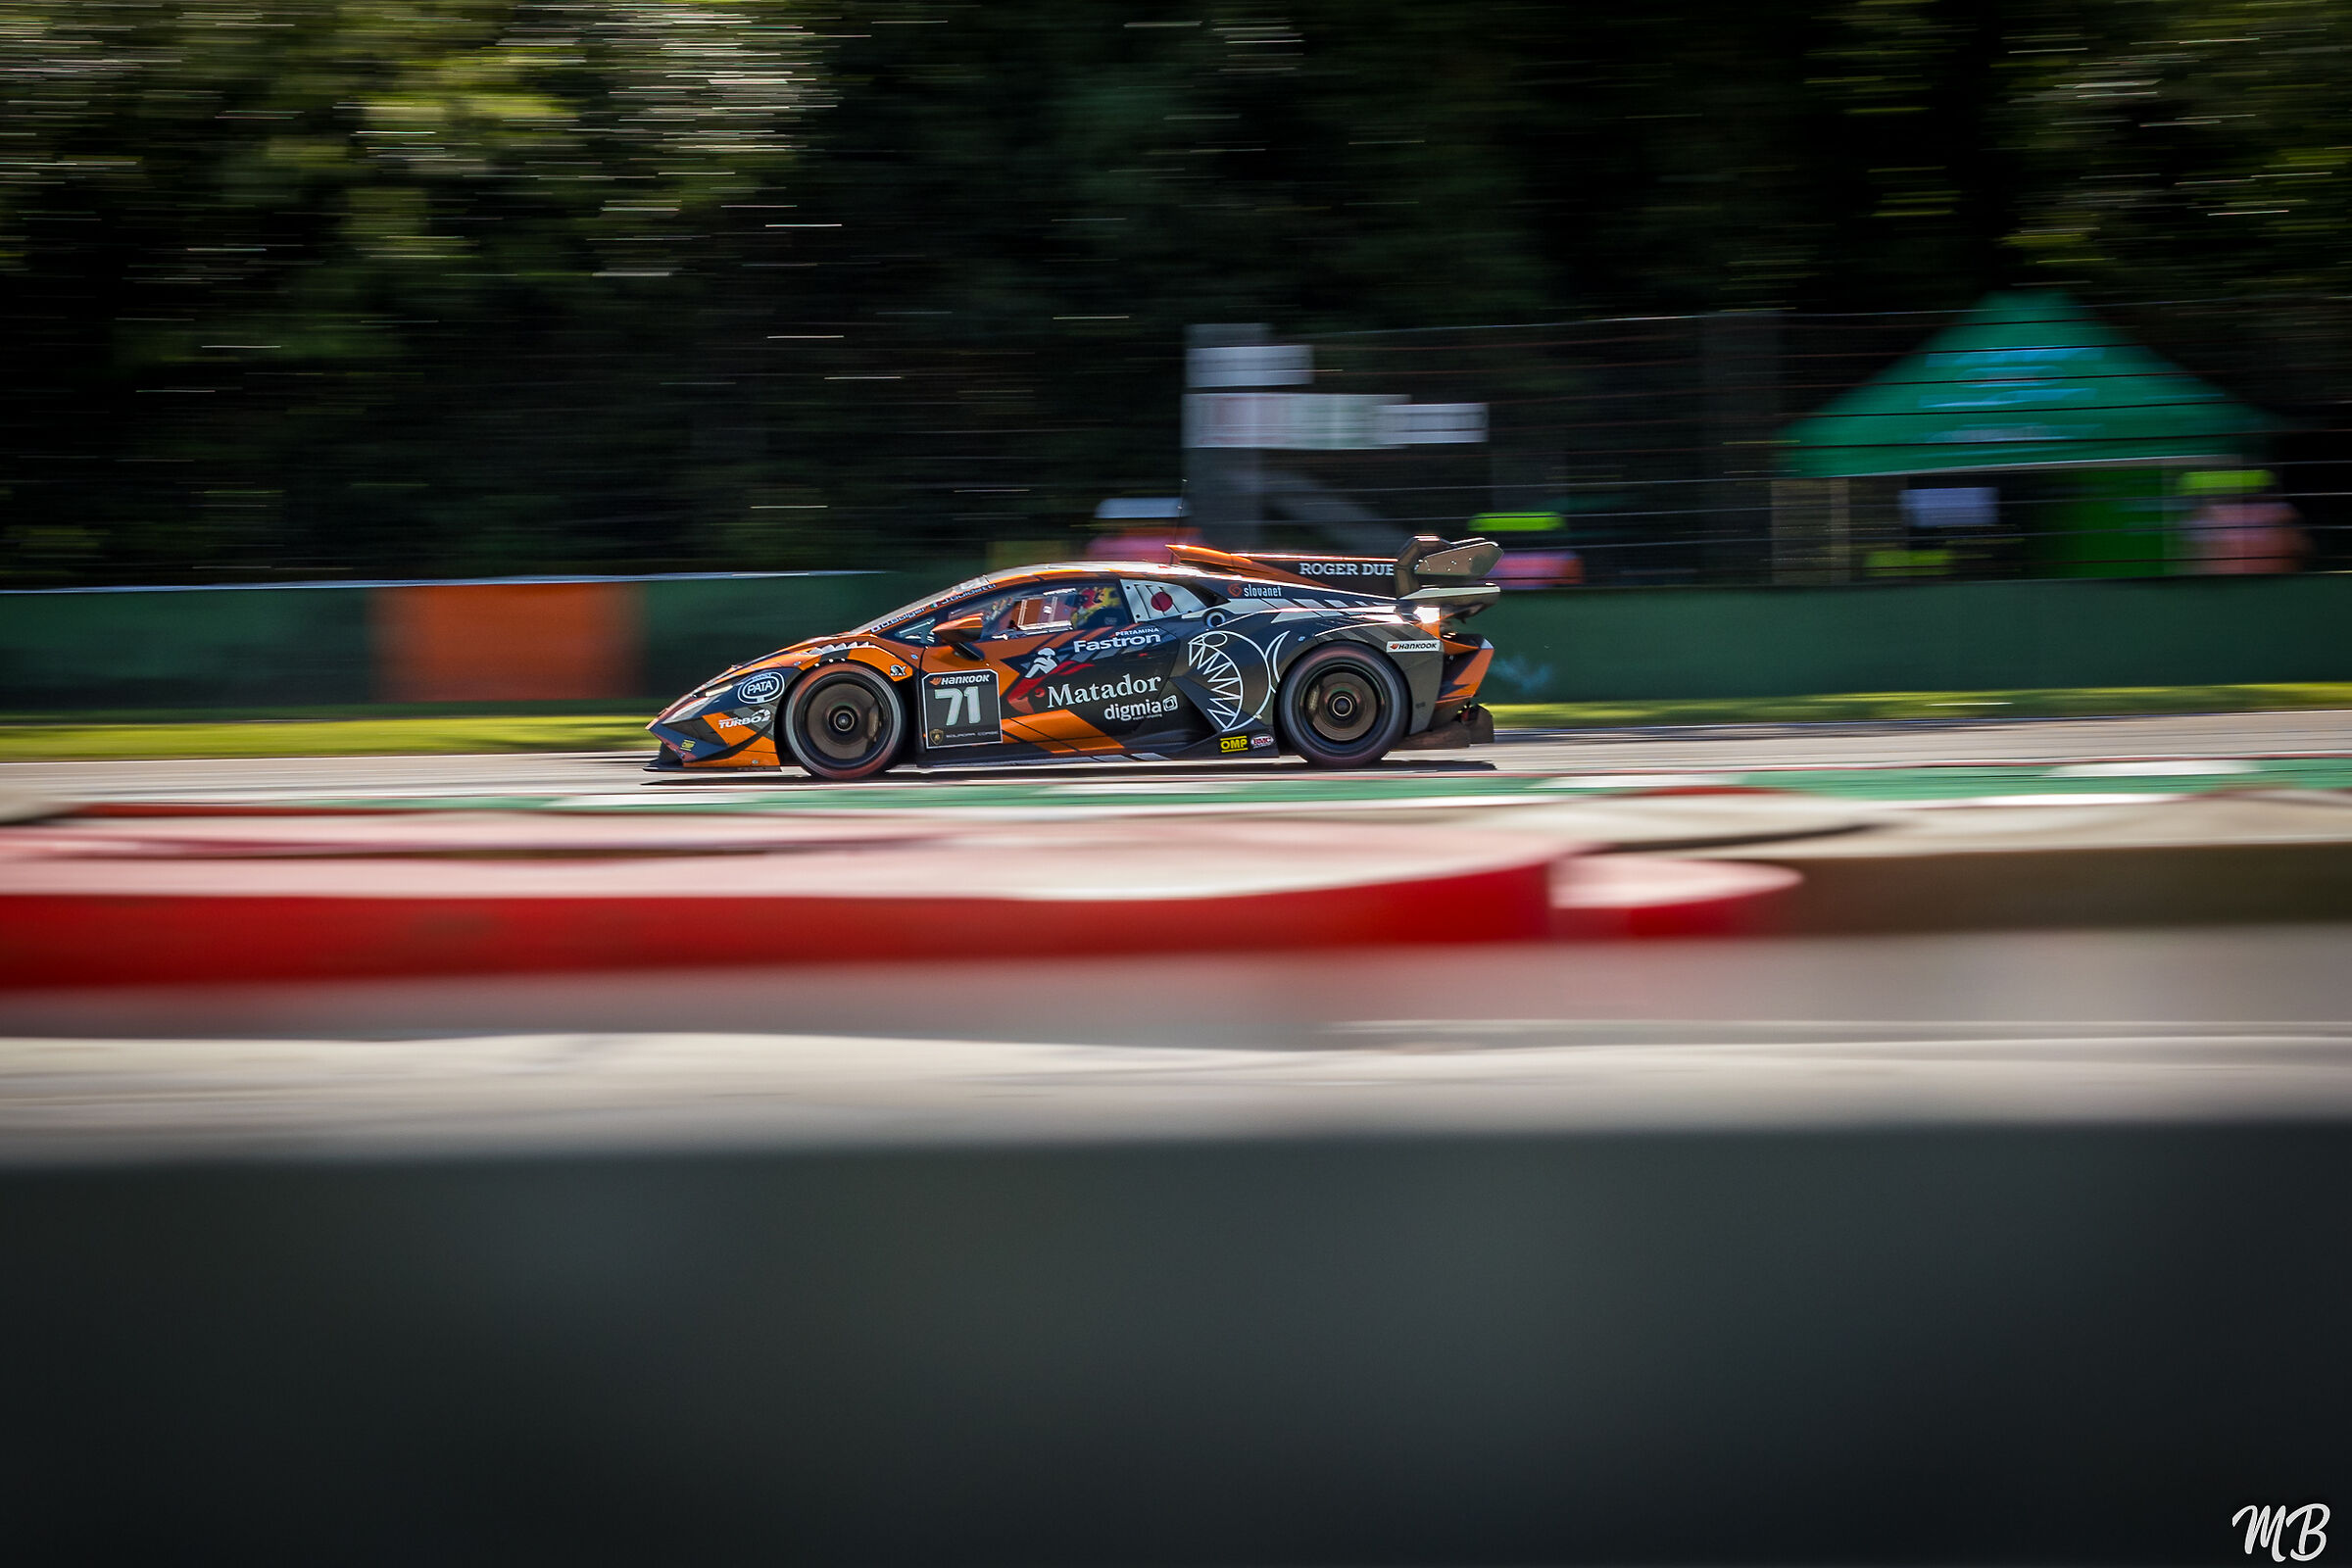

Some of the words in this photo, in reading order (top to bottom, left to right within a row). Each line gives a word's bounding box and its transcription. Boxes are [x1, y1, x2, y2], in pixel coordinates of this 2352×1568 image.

[1298, 563, 1359, 575] ROGER
[1244, 583, 1282, 597] slovanet
[1114, 627, 1160, 637] PERTAMINA
[1073, 634, 1161, 653] Fastron
[747, 680, 774, 695] PATA
[1048, 673, 1161, 709] Matador
[934, 686, 981, 726] 71
[1103, 699, 1162, 721] digmia
[1220, 738, 1248, 750] OMP
